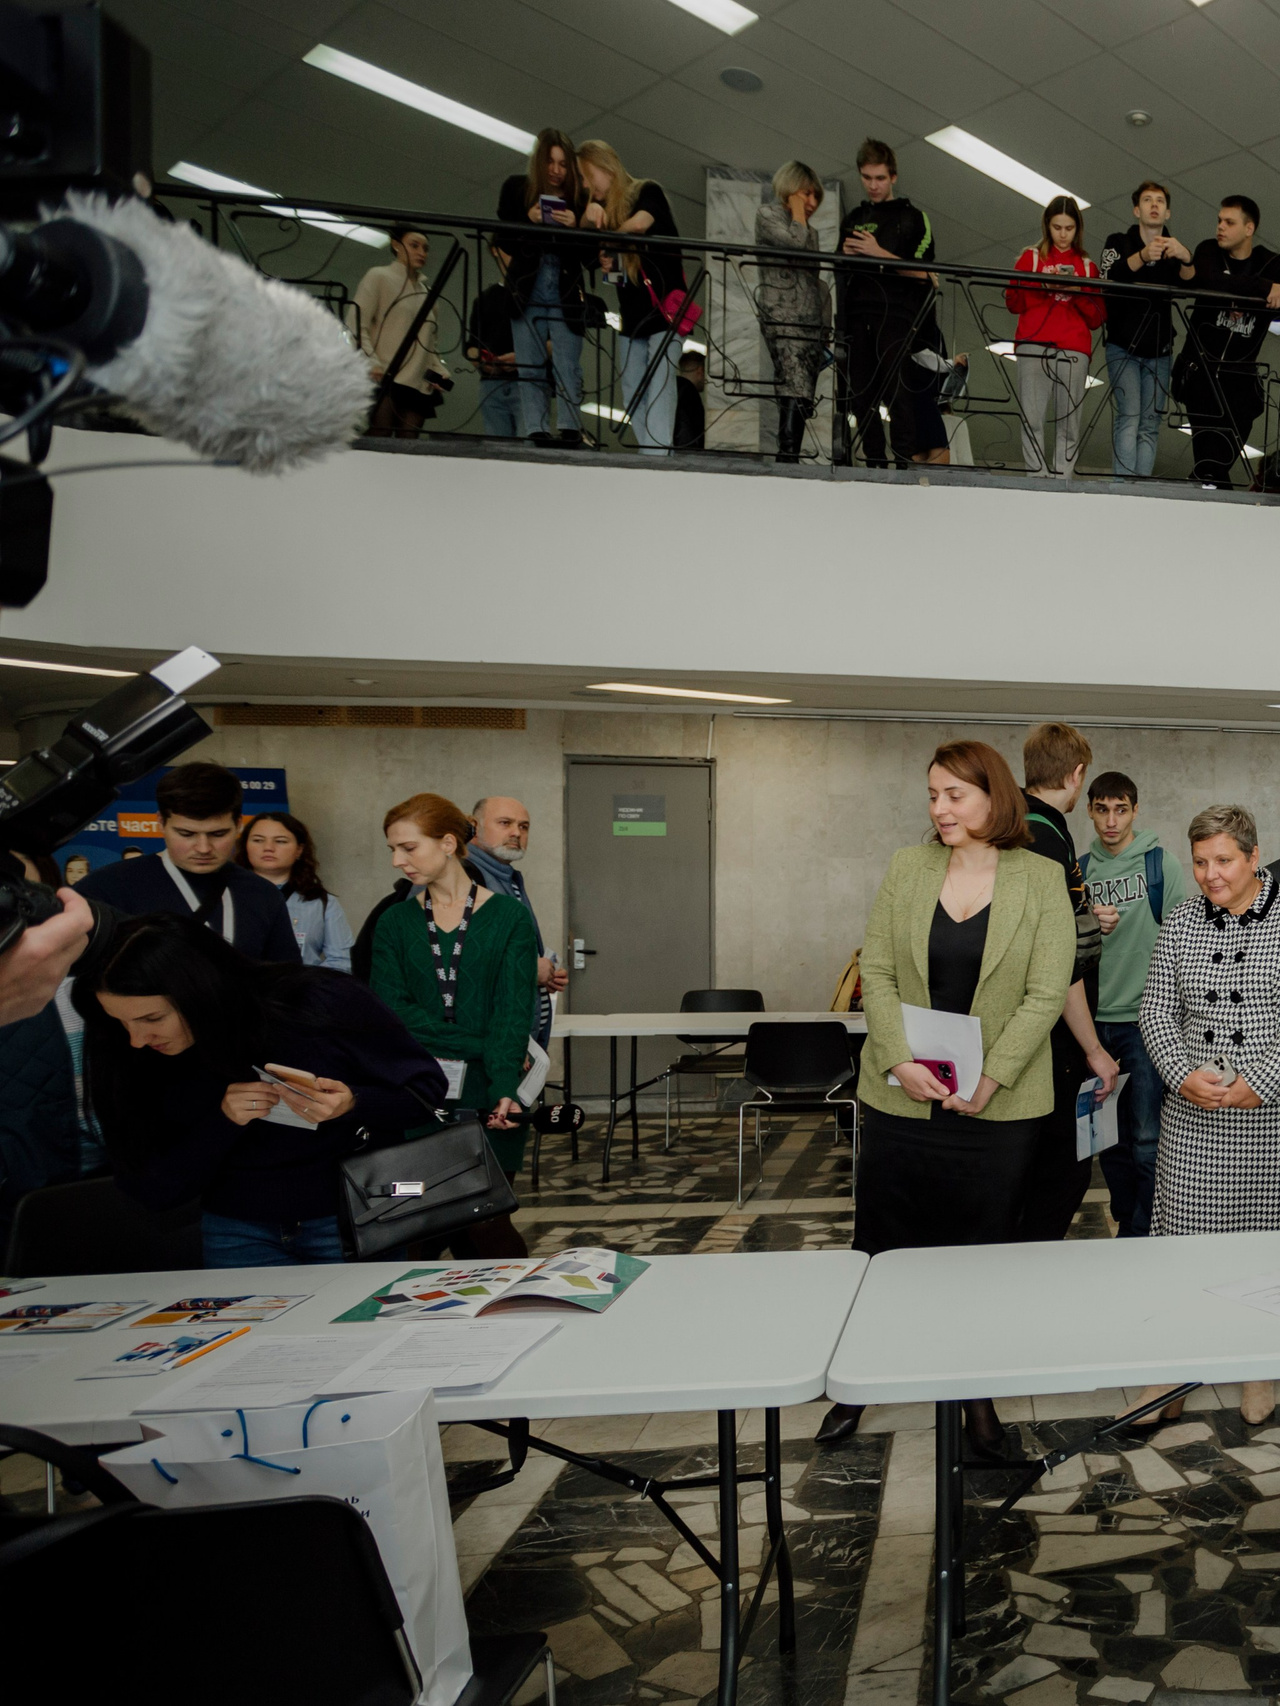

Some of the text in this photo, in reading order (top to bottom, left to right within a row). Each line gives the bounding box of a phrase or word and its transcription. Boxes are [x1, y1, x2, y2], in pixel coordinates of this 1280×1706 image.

[240, 781, 276, 791] 6 00 29
[120, 820, 160, 833] част
[550, 1105, 563, 1123] 360
[572, 1108, 581, 1125] 360
